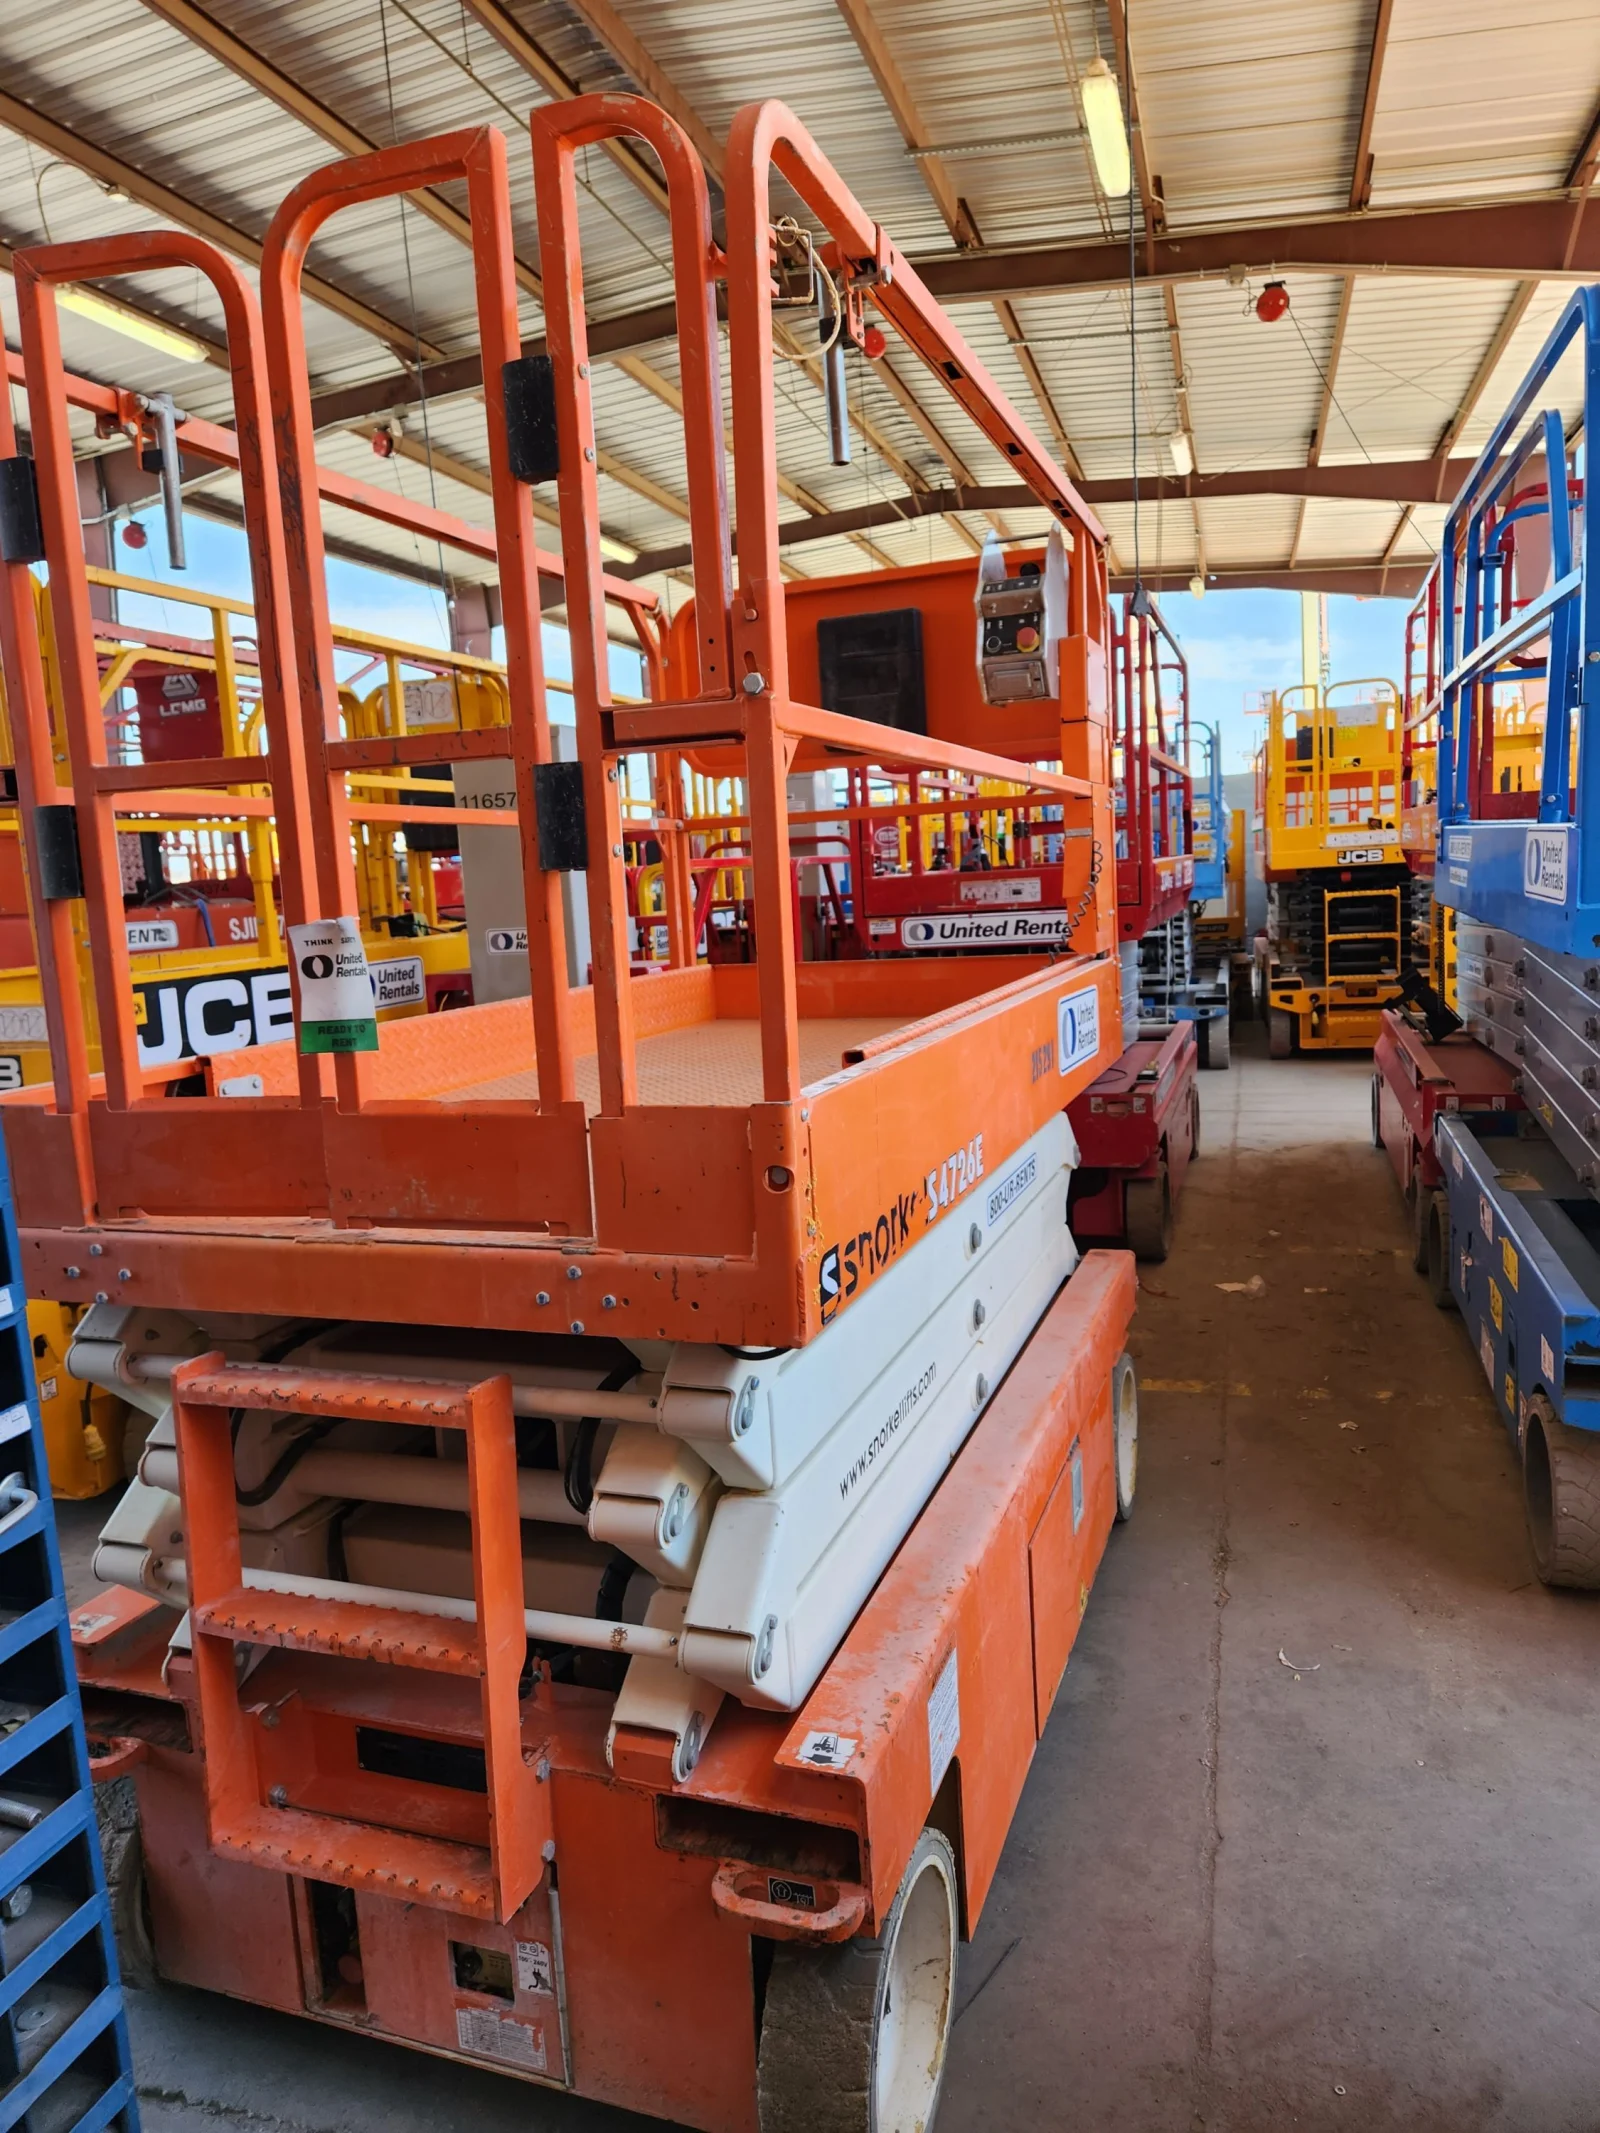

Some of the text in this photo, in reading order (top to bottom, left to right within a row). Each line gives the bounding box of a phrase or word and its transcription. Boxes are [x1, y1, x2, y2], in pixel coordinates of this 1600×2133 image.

[1338, 849, 1383, 864] JCB
[1542, 840, 1564, 864] United
[1540, 865, 1564, 892] Rentals
[940, 918, 1069, 939] United Renta
[304, 938, 333, 947] THINK
[336, 952, 363, 965] United
[336, 966, 367, 978] Rentals
[378, 965, 416, 984] United
[379, 981, 420, 1001] Rentals
[318, 1025, 366, 1035] READY TO
[331, 1039, 357, 1048] RENT
[926, 1132, 984, 1224] S4726E
[989, 1159, 1036, 1220] 800-UR-RENTS
[839, 1361, 937, 1500] www.snorkellifts.com
